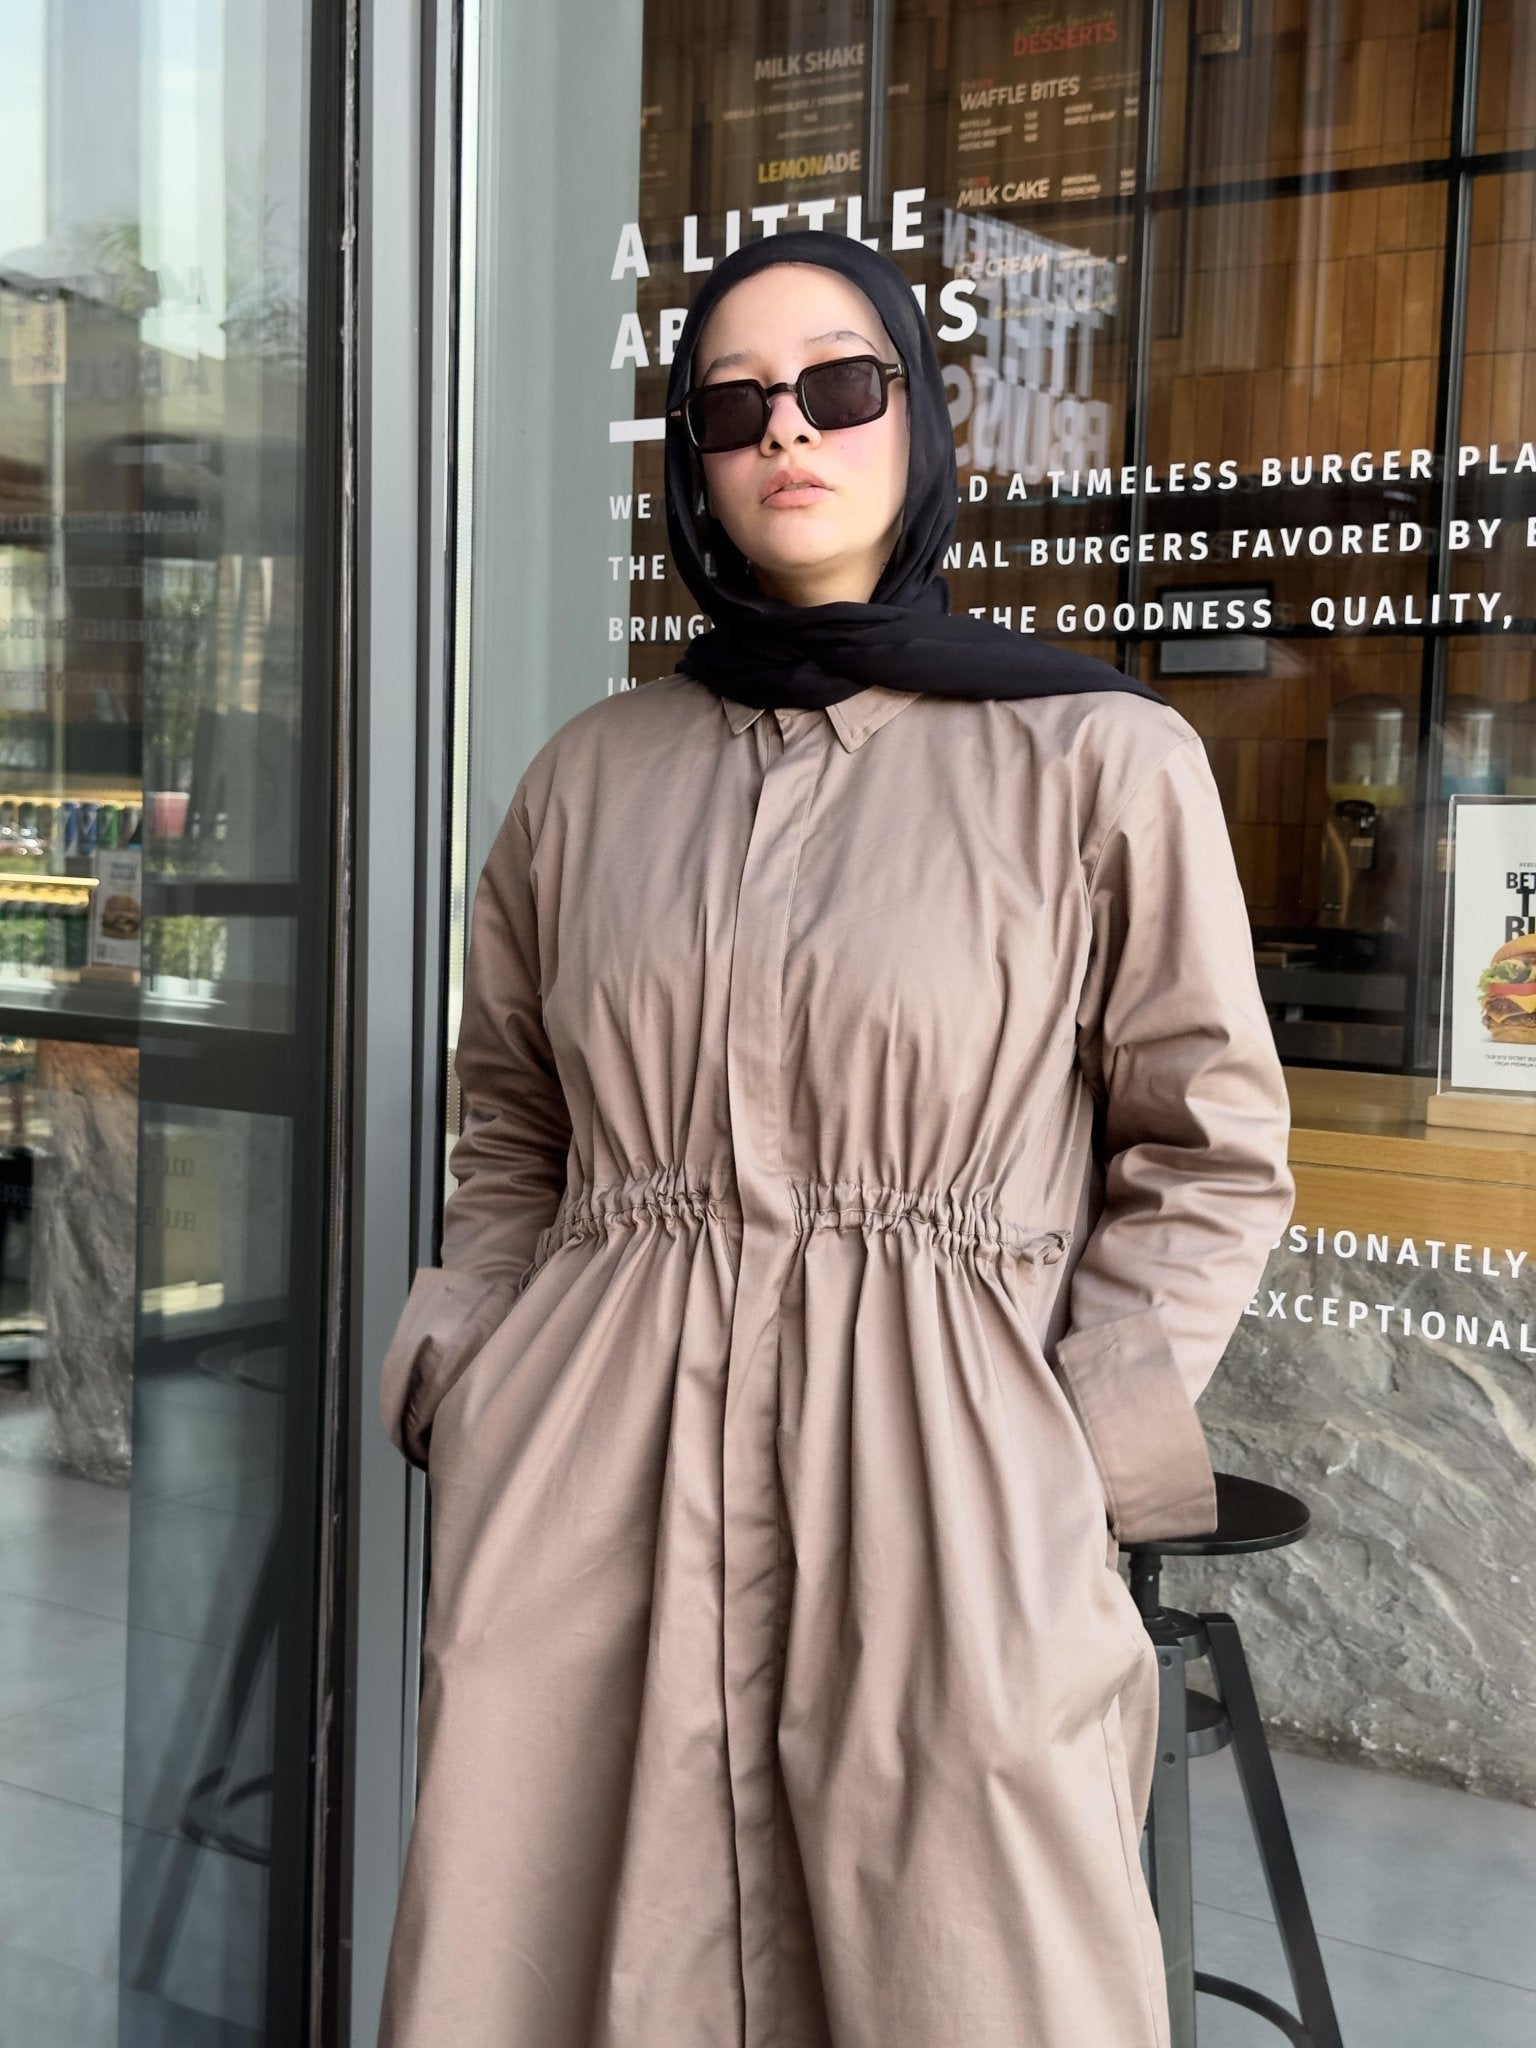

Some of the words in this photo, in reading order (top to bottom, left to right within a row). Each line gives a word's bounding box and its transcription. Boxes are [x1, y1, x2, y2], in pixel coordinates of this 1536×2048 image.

[1013, 21, 1118, 57] DESSERTS
[754, 55, 800, 80] MILK
[960, 83, 1027, 112] WAFFLE
[1030, 76, 1081, 101] BITES
[757, 150, 862, 184] LEMONADE
[957, 185, 1000, 209] MILK
[1001, 178, 1050, 203] CAKE
[611, 223, 650, 280] A
[1006, 473, 1028, 501] A
[1047, 460, 1239, 498] TIMELESS
[1261, 449, 1433, 487] BURGER
[609, 493, 652, 520] WE
[1030, 531, 1209, 567] BURGERS
[1231, 522, 1423, 559] FAVORED
[1449, 518, 1502, 550] BY
[608, 554, 666, 581] THE
[608, 614, 716, 642] BRING
[1056, 599, 1273, 633] GOODNESS
[1310, 592, 1513, 631] QUALITY,
[1271, 1224, 1529, 1279] SIONATELY
